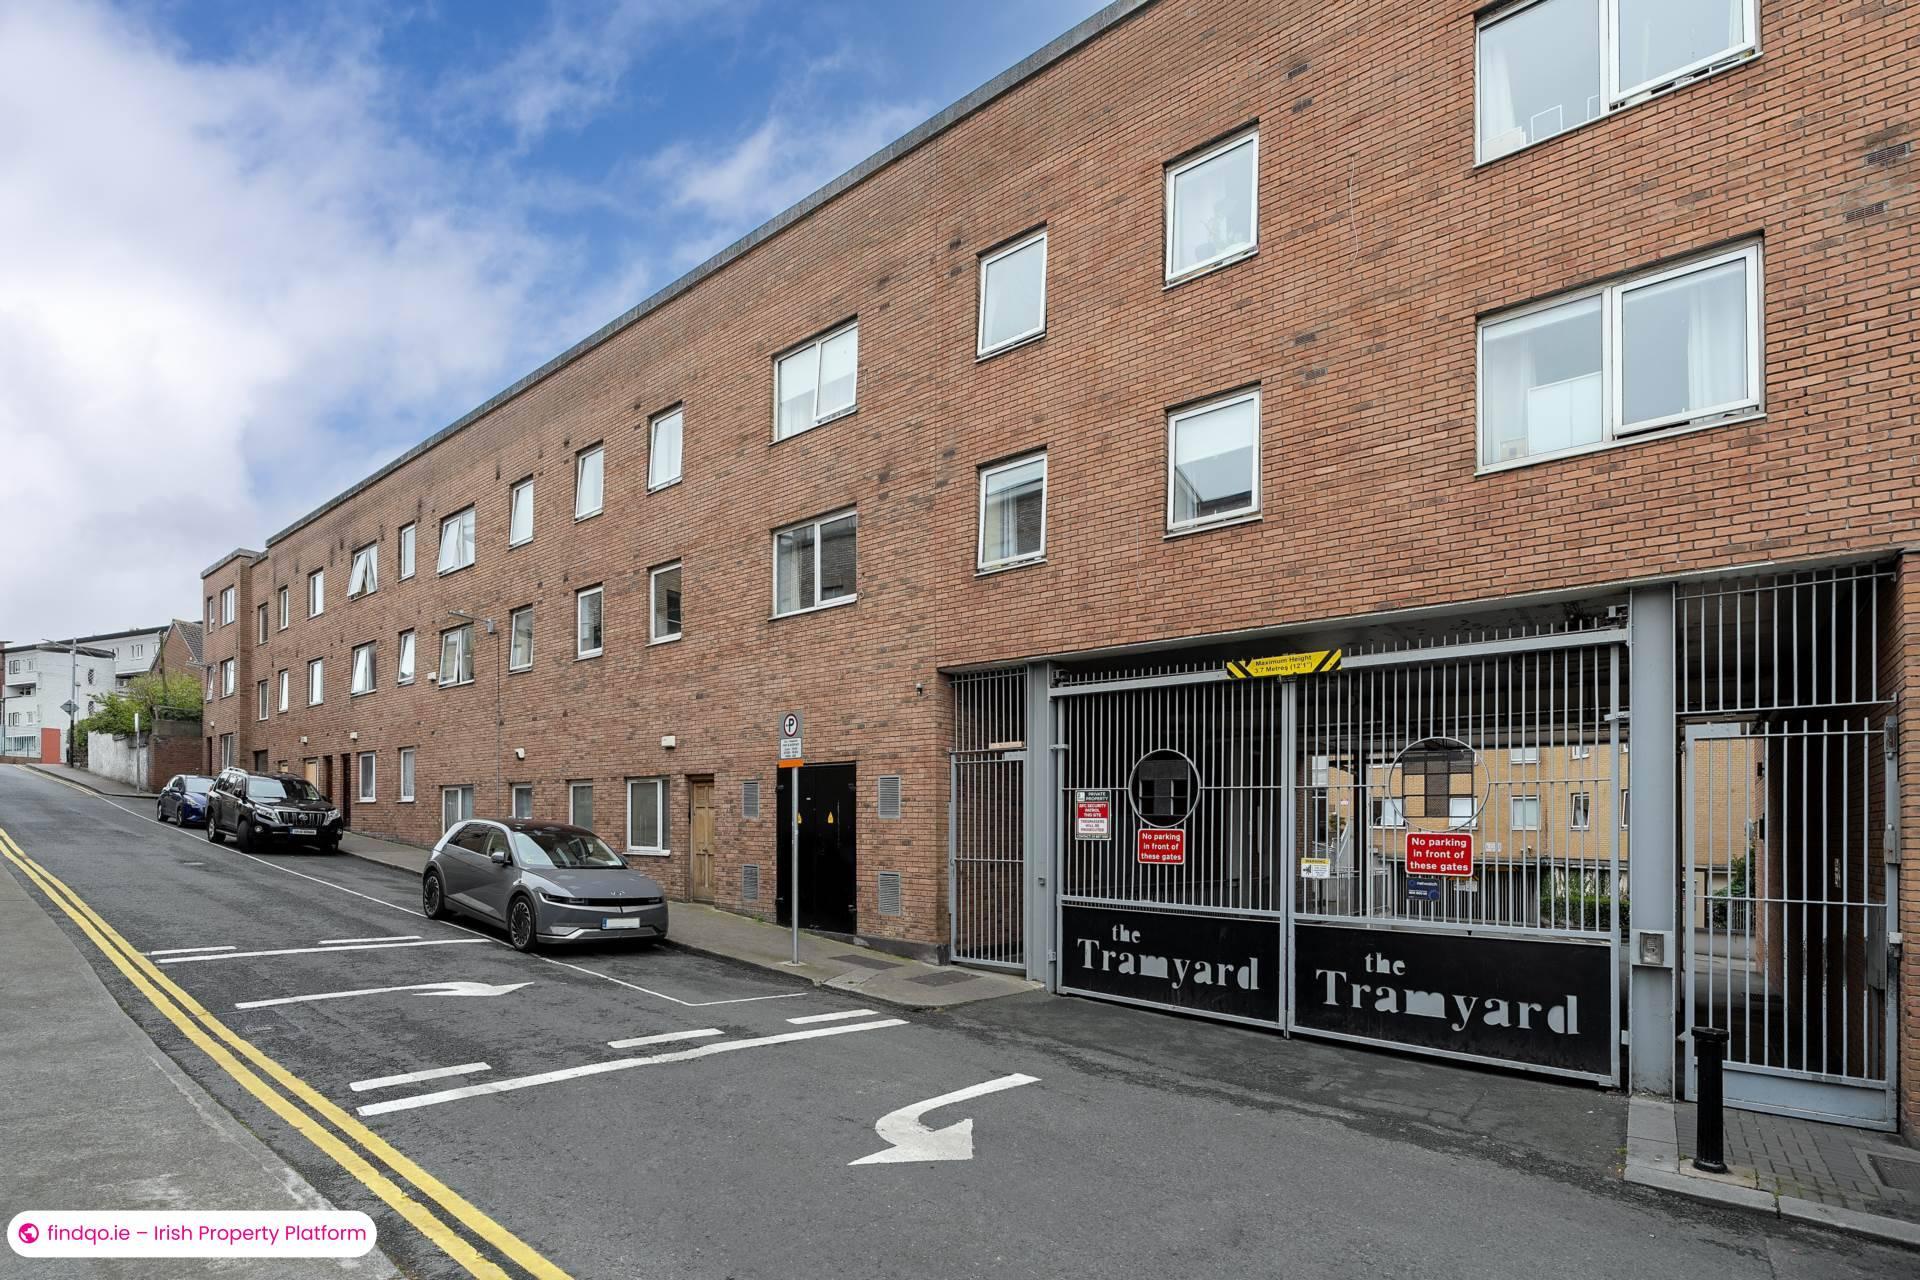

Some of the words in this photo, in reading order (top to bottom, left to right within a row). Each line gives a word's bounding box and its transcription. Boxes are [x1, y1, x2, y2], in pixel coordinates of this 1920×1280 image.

[1256, 658, 1287, 666] Maximum
[1154, 833, 1180, 841] parking
[1429, 838, 1467, 848] parking
[1425, 850, 1450, 858] front
[1410, 861, 1437, 869] these
[1440, 863, 1468, 871] gates
[1112, 924, 1140, 943] the
[1077, 938, 1260, 990] Tramyard
[1364, 952, 1406, 976] the
[1316, 969, 1581, 1035] Tramyard
